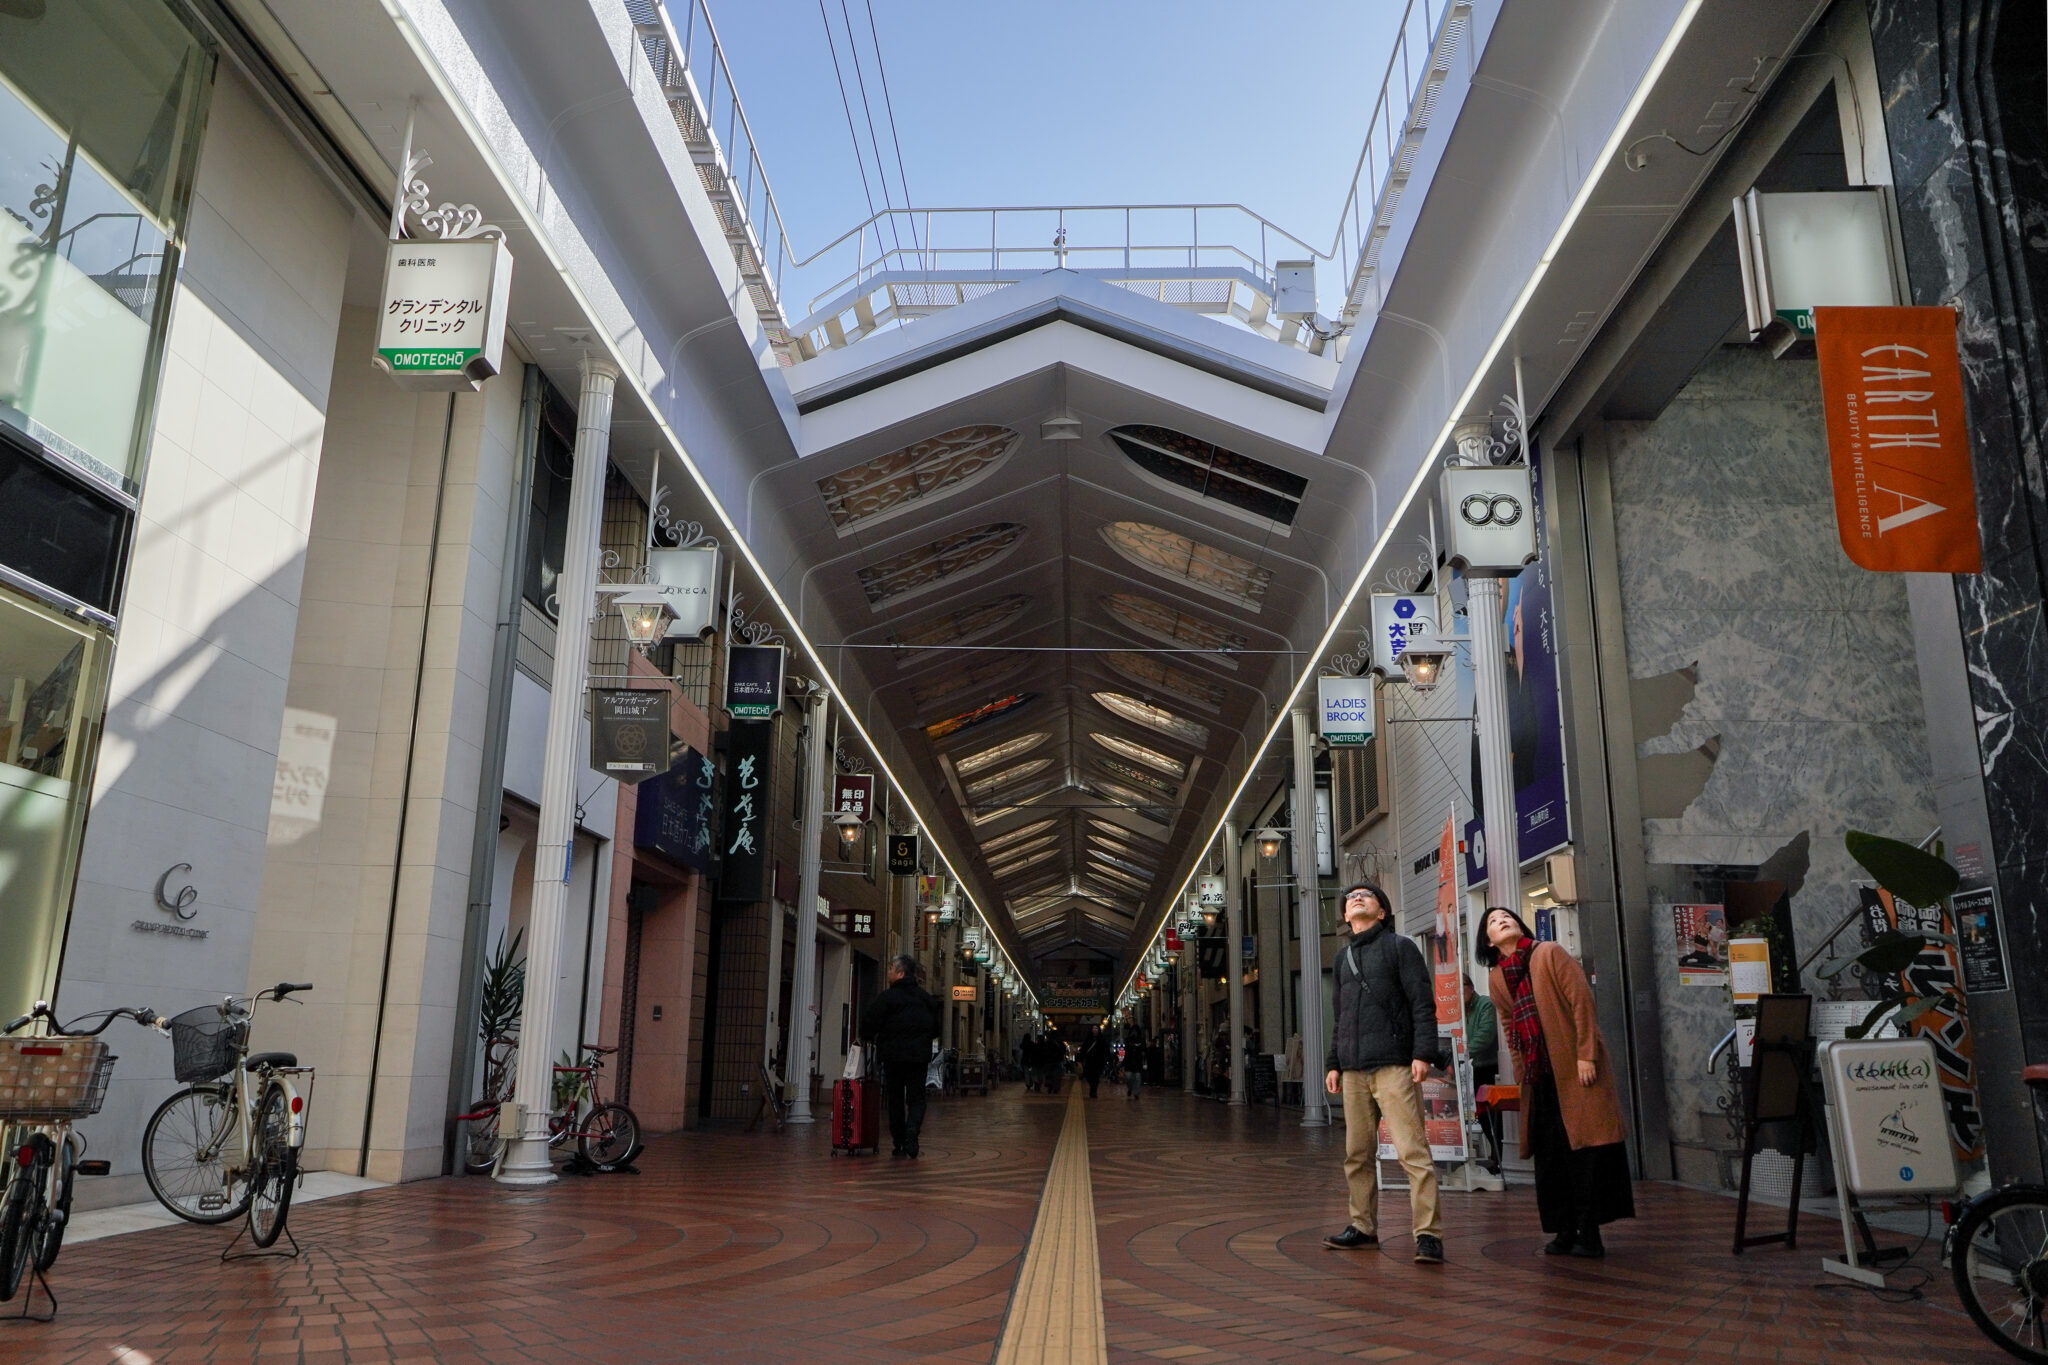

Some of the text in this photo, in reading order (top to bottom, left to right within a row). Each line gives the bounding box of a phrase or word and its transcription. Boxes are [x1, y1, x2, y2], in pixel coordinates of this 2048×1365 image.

[397, 258, 436, 267] 歯科医院
[388, 298, 483, 315] グランデンタル
[399, 318, 466, 334] クリニック
[1860, 342, 1942, 449] EARTH
[1846, 393, 1861, 440] BEAUTY
[1852, 452, 1872, 539] INTELLIGENCE
[733, 686, 764, 694] 日本酒カフェ
[602, 696, 661, 706] アルファガーデン
[1326, 698, 1367, 709] LADIES
[614, 705, 649, 716] 岡山城下
[1326, 711, 1366, 722] BROOK
[842, 787, 865, 800] 無印
[840, 800, 864, 812] 良品
[854, 913, 872, 924] 無印
[854, 923, 871, 934] 良品
